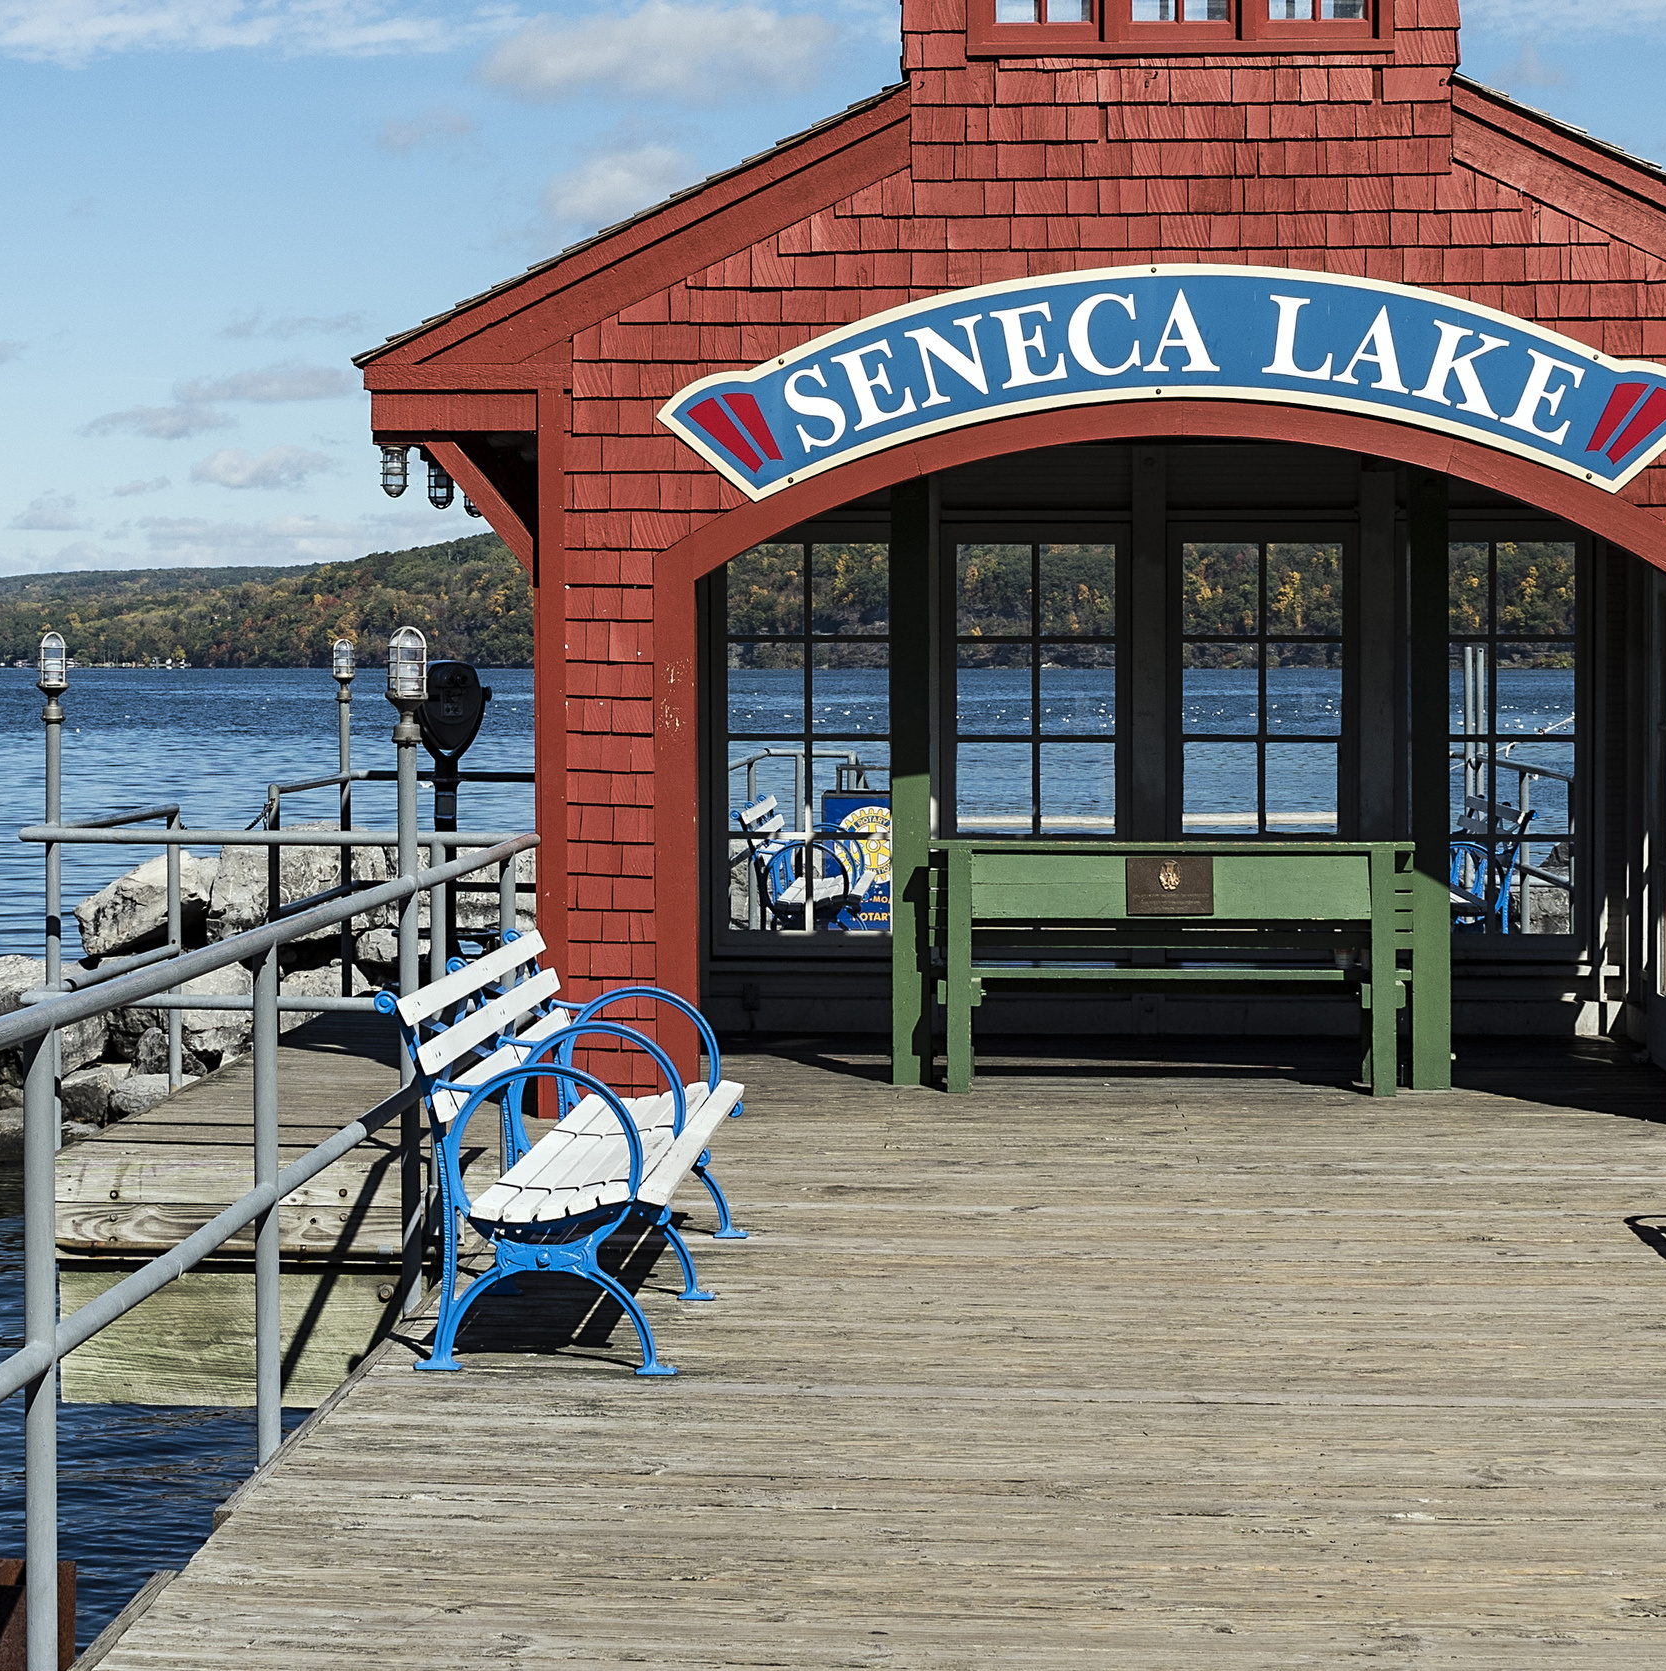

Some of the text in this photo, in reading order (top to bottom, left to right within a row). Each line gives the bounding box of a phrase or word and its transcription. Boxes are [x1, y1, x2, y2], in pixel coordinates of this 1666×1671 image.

[784, 288, 1586, 454] SENECA LAKE
[857, 816, 890, 827] ROTARY
[852, 912, 891, 922] OTAR
